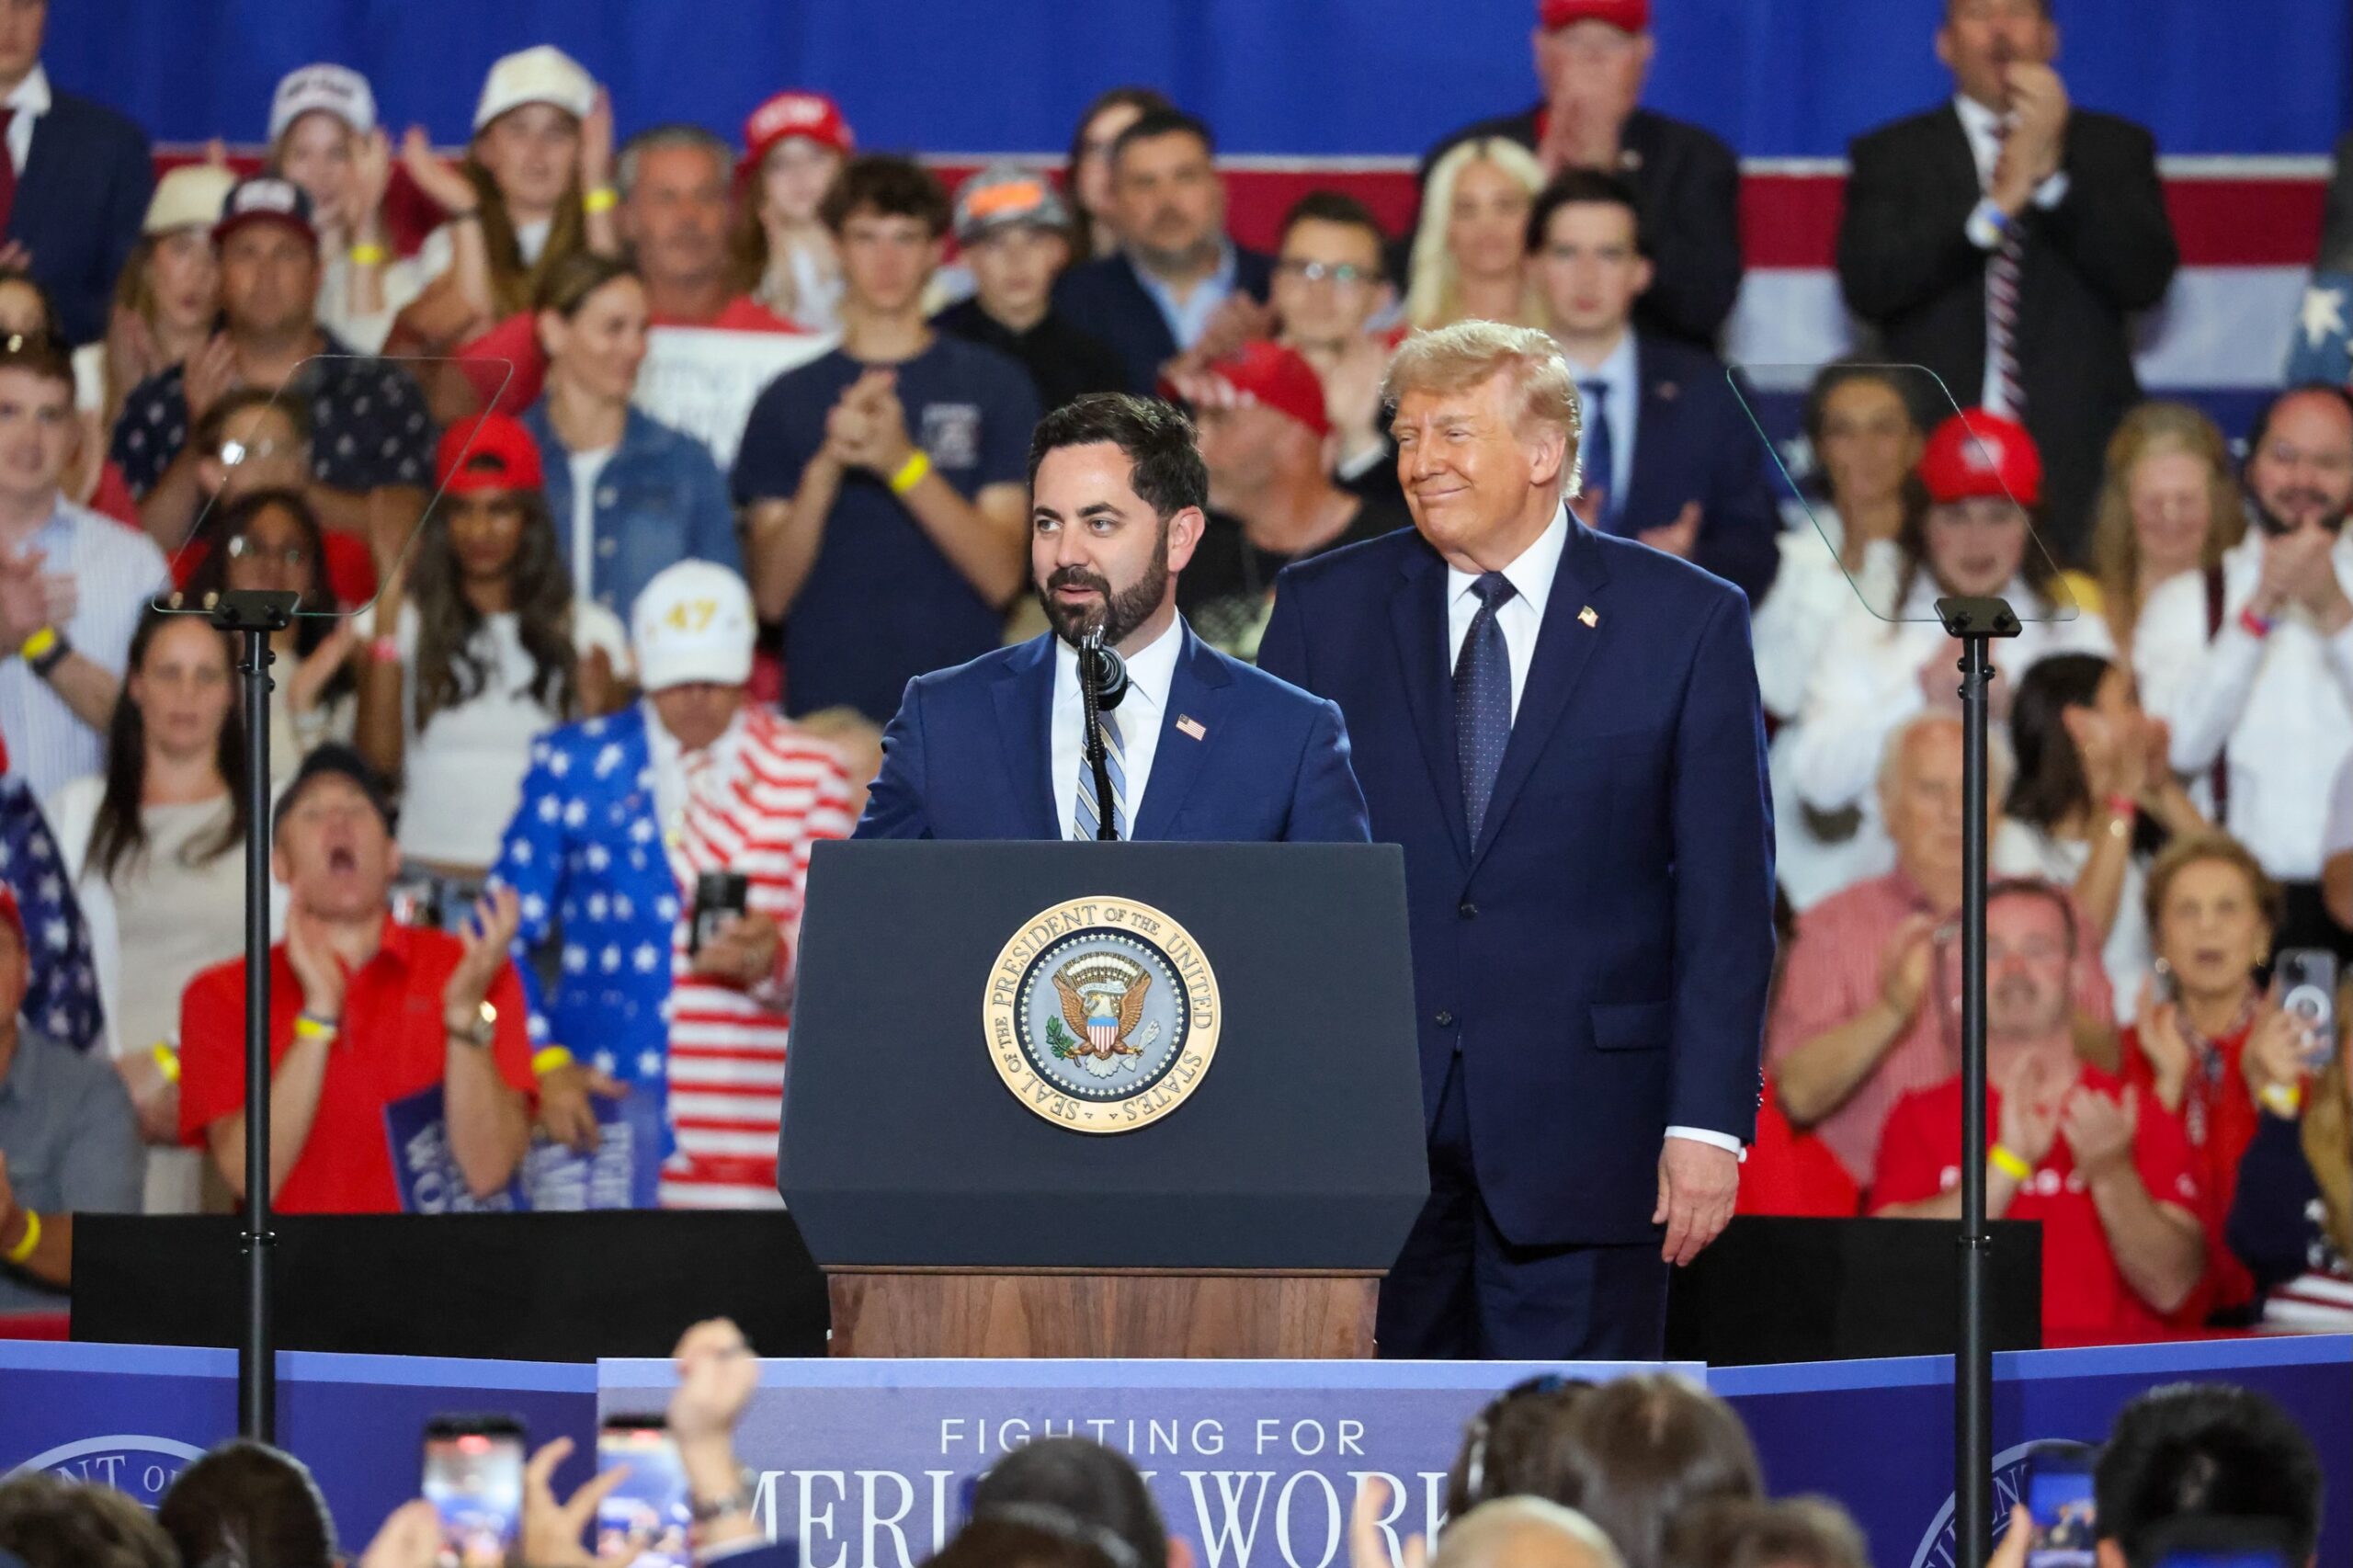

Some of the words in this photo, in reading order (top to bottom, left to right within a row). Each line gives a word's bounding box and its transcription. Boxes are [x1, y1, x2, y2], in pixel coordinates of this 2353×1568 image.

[664, 599, 718, 631] 47
[1104, 907, 1127, 922] OF
[1131, 913, 1161, 937] THE
[993, 903, 1097, 1008] PRESIDENT
[1165, 932, 1213, 1029] UNITED
[995, 1016, 1012, 1050] THE
[1003, 1052, 1022, 1073] OF
[1020, 1072, 1081, 1120] SEAL
[1122, 1050, 1203, 1121] STATES
[940, 1418, 1224, 1455] FIGHTING
[1256, 1418, 1366, 1456] FOR
